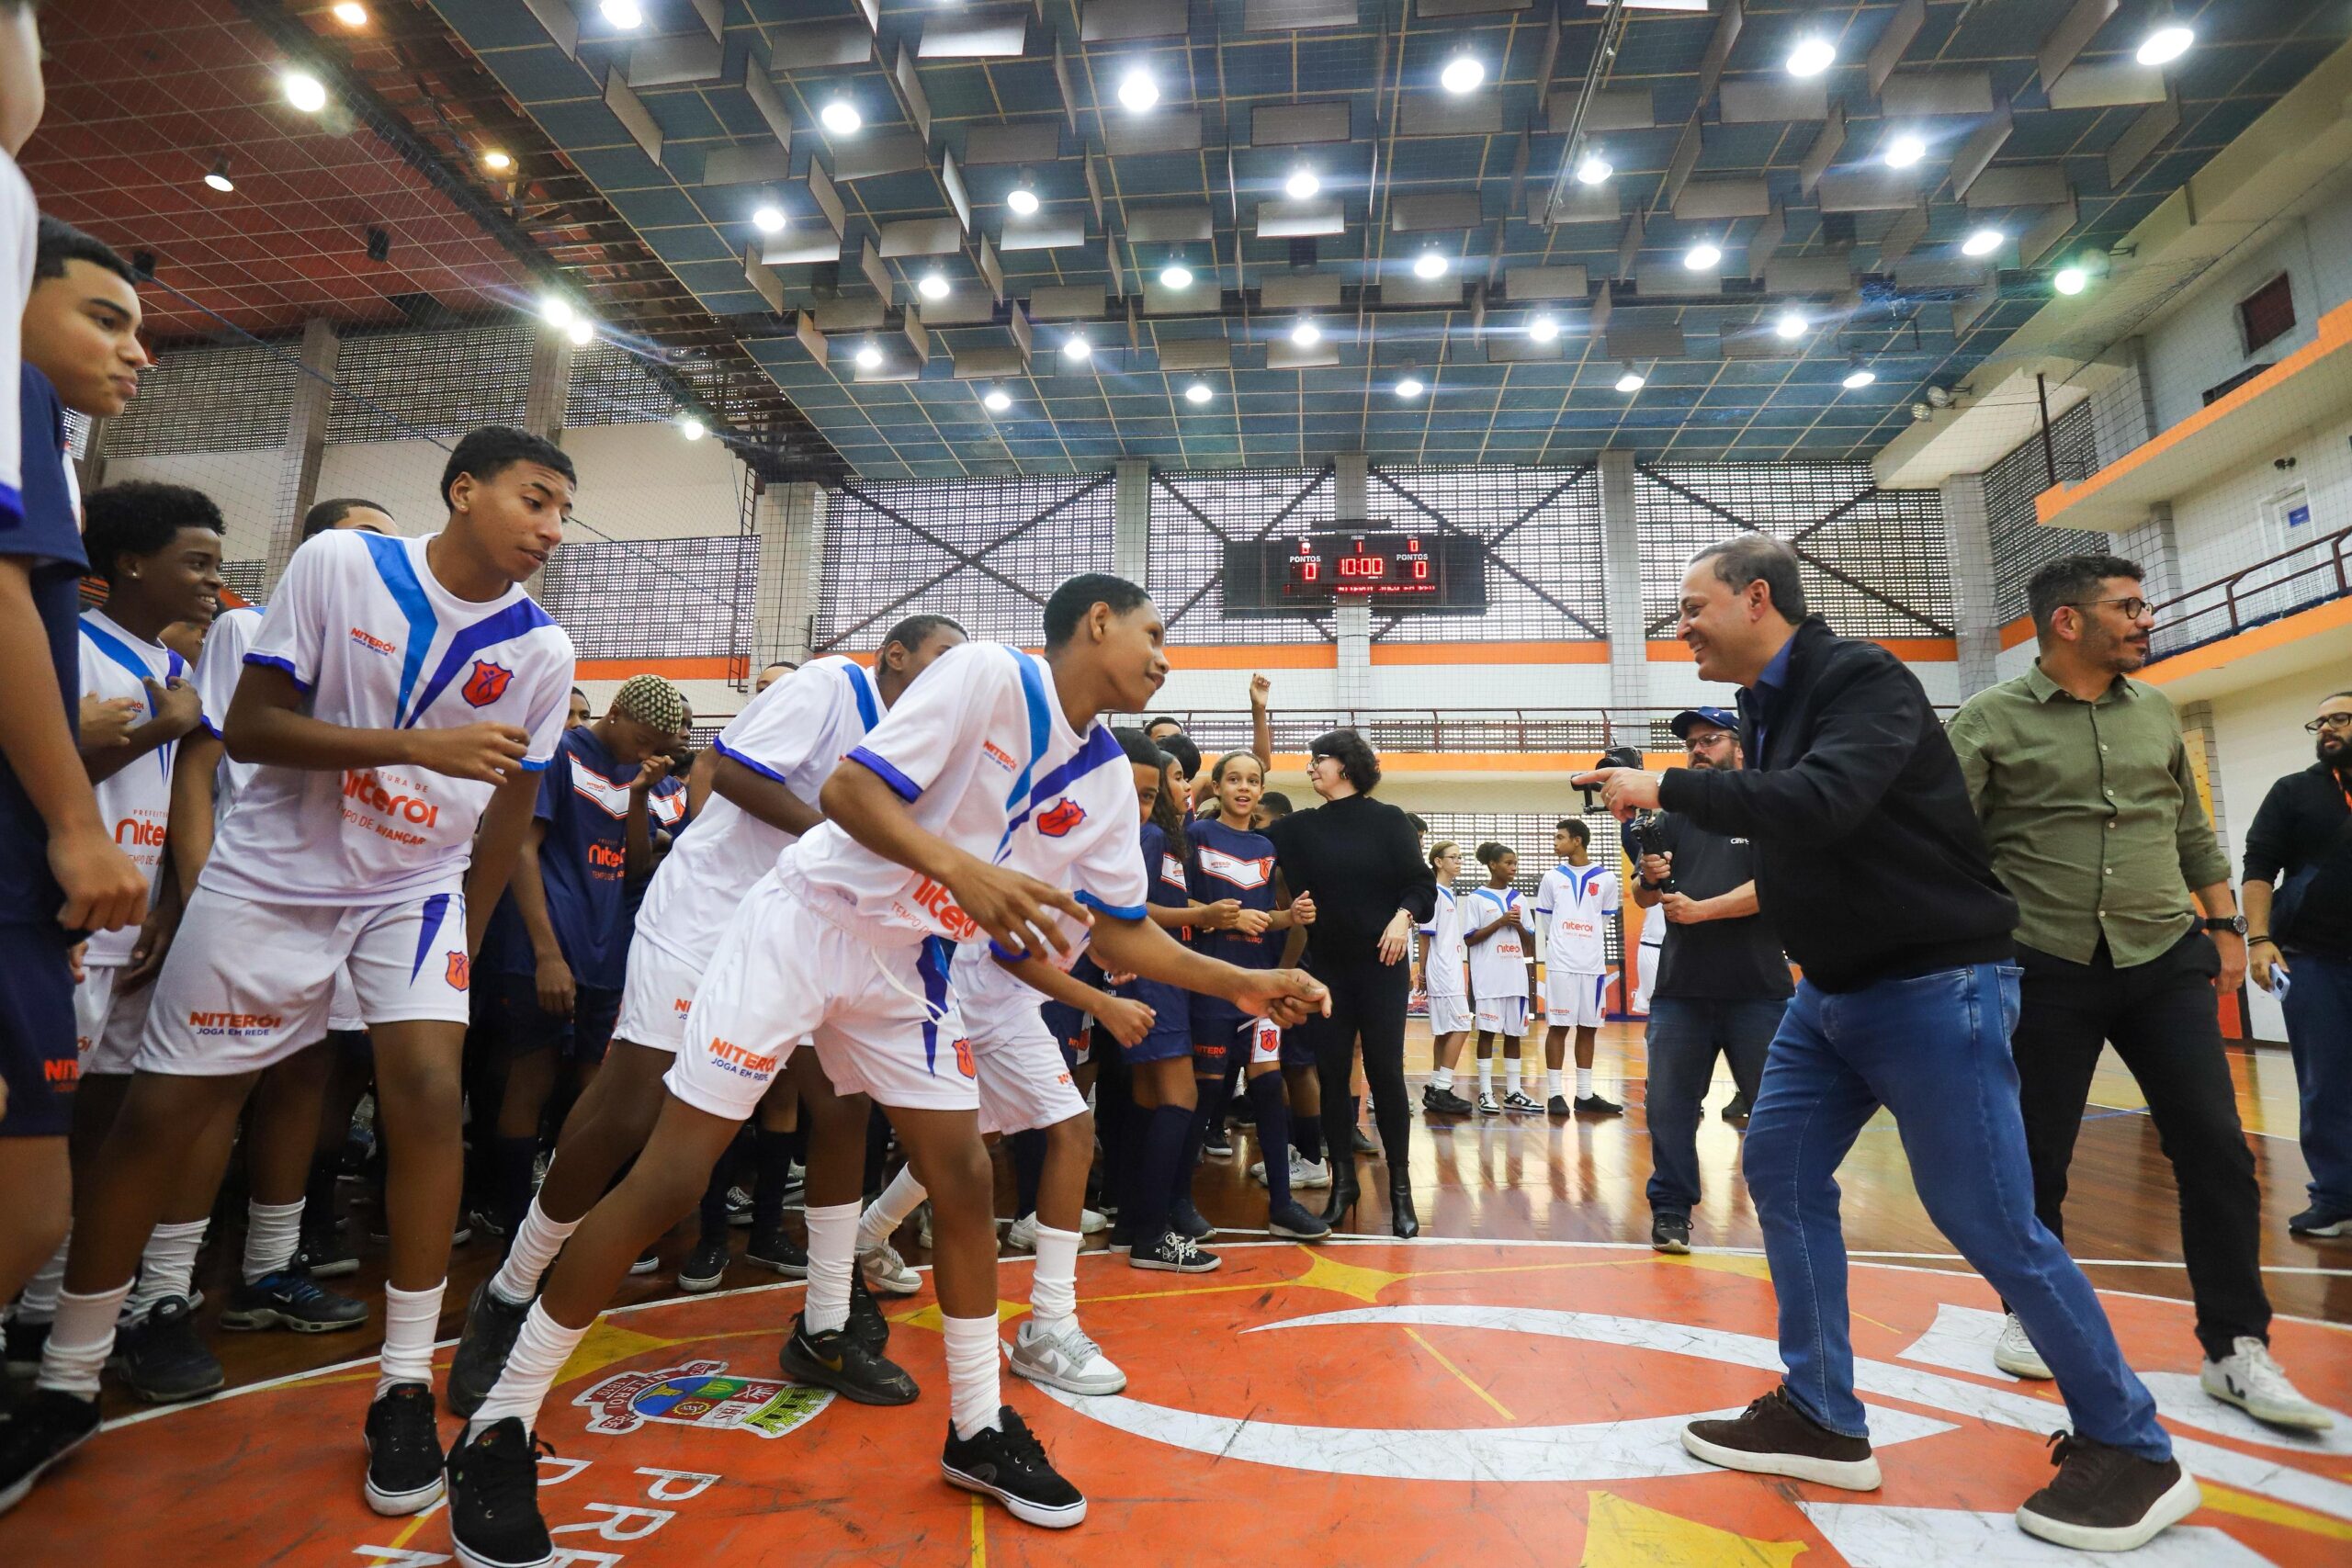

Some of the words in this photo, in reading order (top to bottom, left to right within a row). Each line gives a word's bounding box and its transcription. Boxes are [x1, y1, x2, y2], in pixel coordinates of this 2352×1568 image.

[1396, 553, 1429, 561] PONTOS
[1305, 562, 1317, 580] 0
[1340, 558, 1384, 575] 10:00
[1415, 560, 1427, 578] 0
[350, 626, 396, 654] NITERÓI
[189, 1011, 282, 1029] NITERÓI
[197, 1028, 225, 1036] JOGA
[228, 1028, 242, 1037] EM
[244, 1029, 269, 1037] REDE
[711, 1058, 737, 1074] JOGA
[739, 1068, 752, 1079] EM
[596, 1382, 625, 1396] 1819
